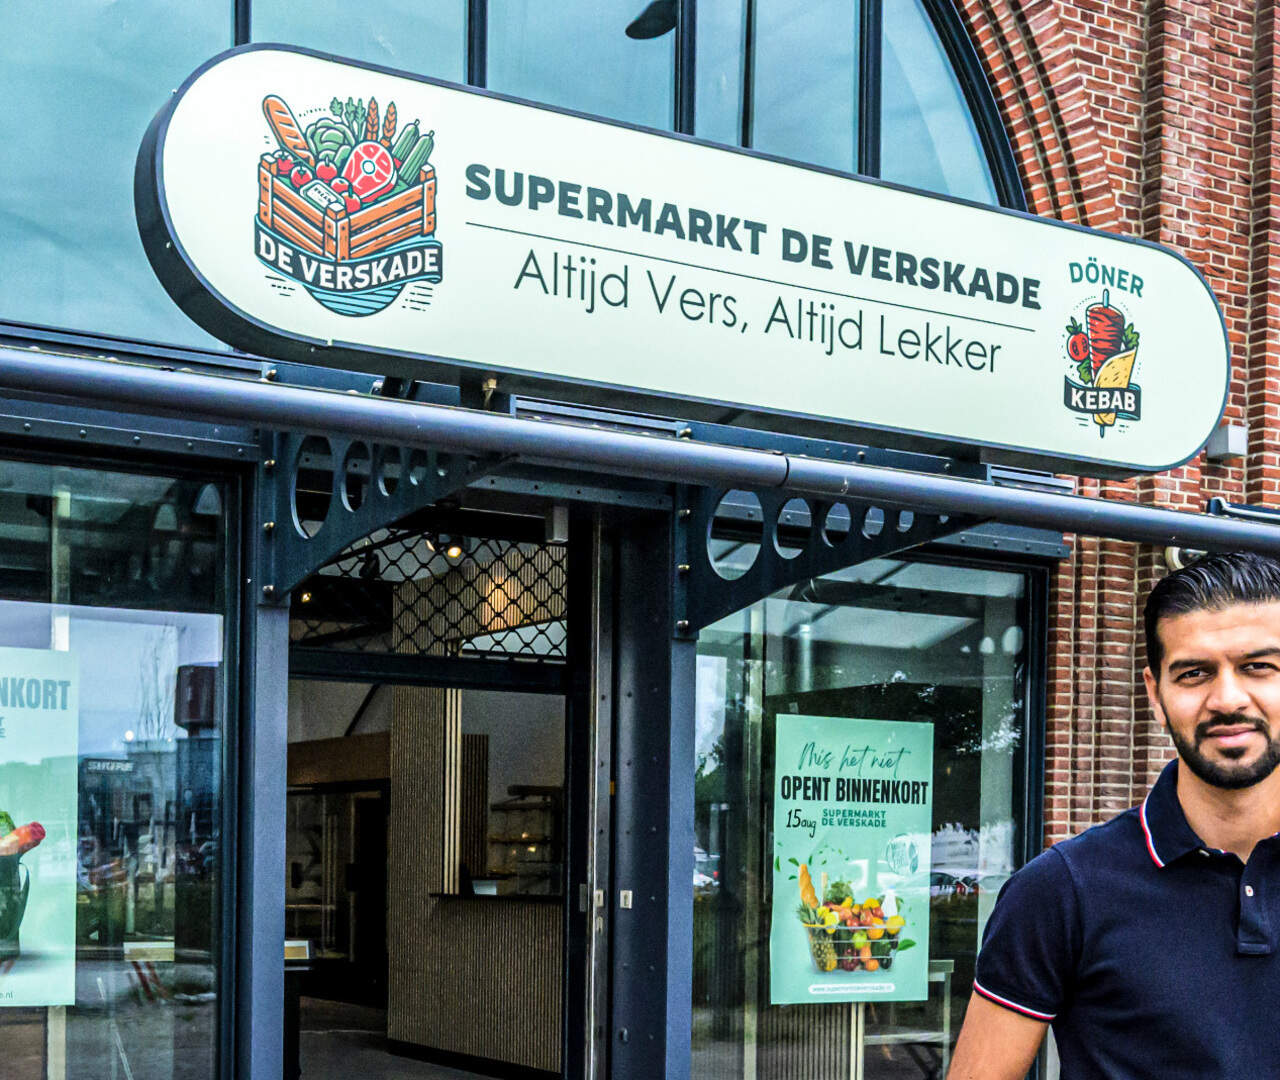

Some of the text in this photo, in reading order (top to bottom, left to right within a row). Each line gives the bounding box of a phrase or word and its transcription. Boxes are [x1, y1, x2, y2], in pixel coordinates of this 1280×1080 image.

[465, 163, 1042, 311] SUPERMARKT DE VERSKADE
[258, 230, 440, 290] DE VERSKADE
[1069, 256, 1144, 298] DÖNER
[513, 248, 1002, 373] Altijd Vers, Altijd Lekker
[1071, 387, 1136, 412] KEBAB
[798, 742, 912, 779] Mis het niet
[781, 775, 929, 805] OPENT BINNENKORT
[786, 808, 817, 838] 15 aug
[821, 818, 887, 828] DE VERSKADE
[822, 808, 887, 819] SUPERMARKT
